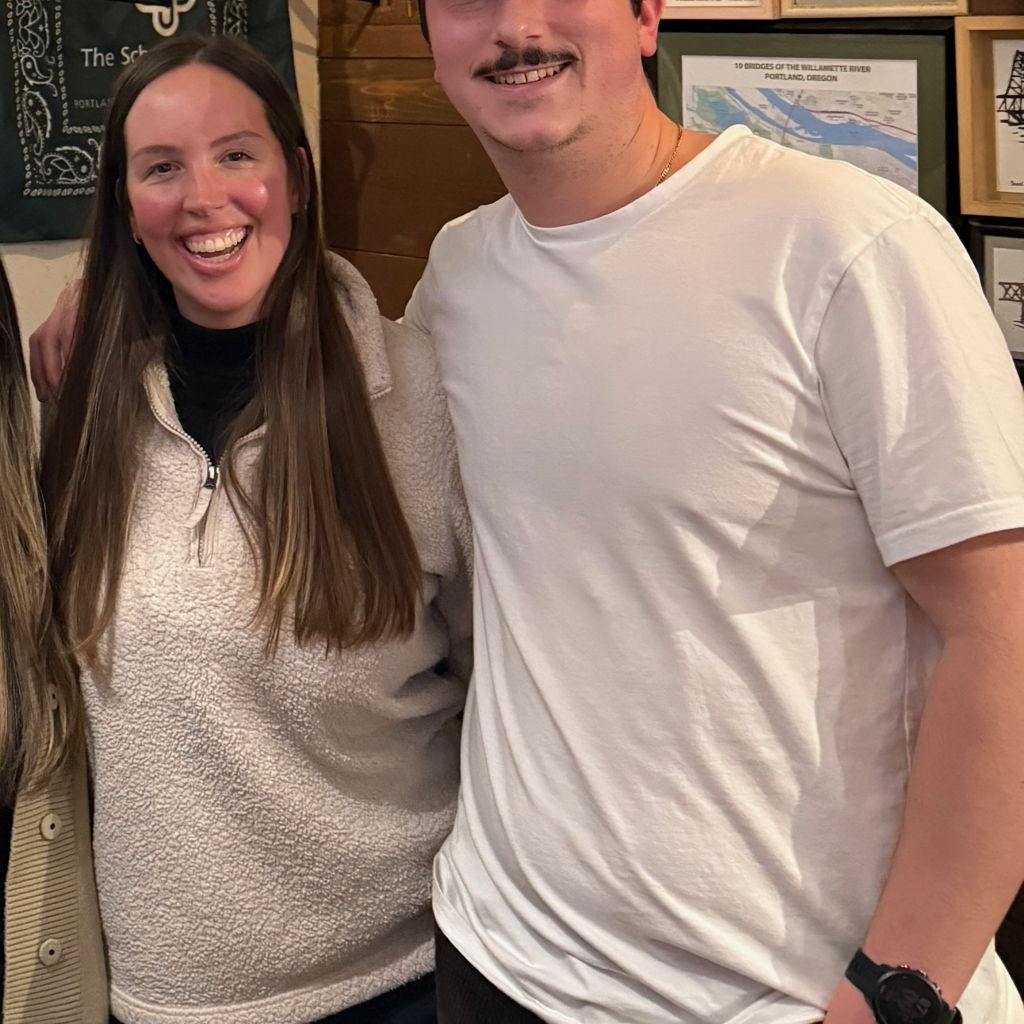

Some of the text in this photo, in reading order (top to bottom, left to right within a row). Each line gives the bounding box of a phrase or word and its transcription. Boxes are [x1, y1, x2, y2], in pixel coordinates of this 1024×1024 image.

[80, 47, 115, 67] The
[744, 62, 774, 70] BRIDGES
[786, 63, 801, 71] THE
[801, 63, 848, 72] WILLAMETTE
[849, 65, 872, 73] RIVER
[764, 72, 838, 82] PORTLAND, OREGON
